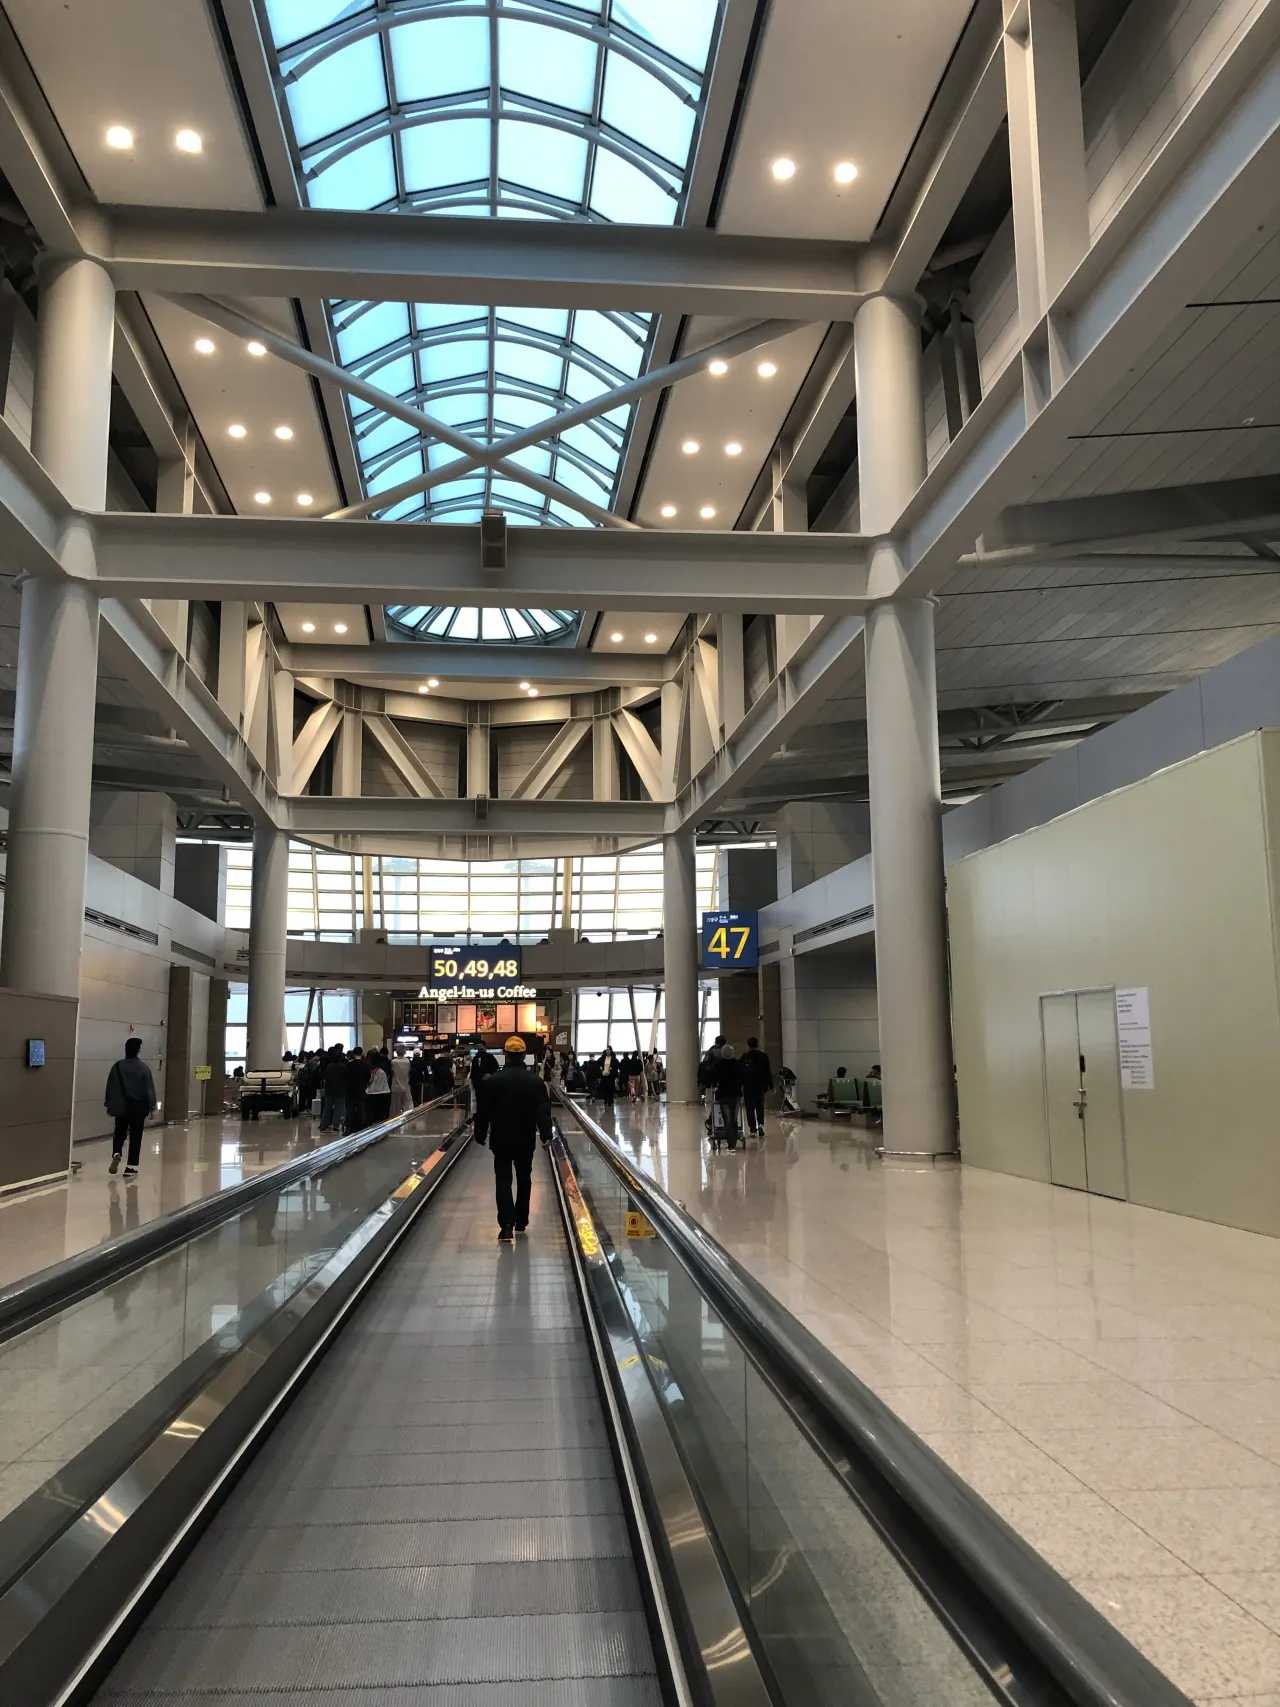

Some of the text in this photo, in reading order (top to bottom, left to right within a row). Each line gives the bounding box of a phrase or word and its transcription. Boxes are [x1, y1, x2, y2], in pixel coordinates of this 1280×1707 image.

[708, 927, 750, 958] 47
[418, 986, 537, 1001] Angel-in-us Coffee
